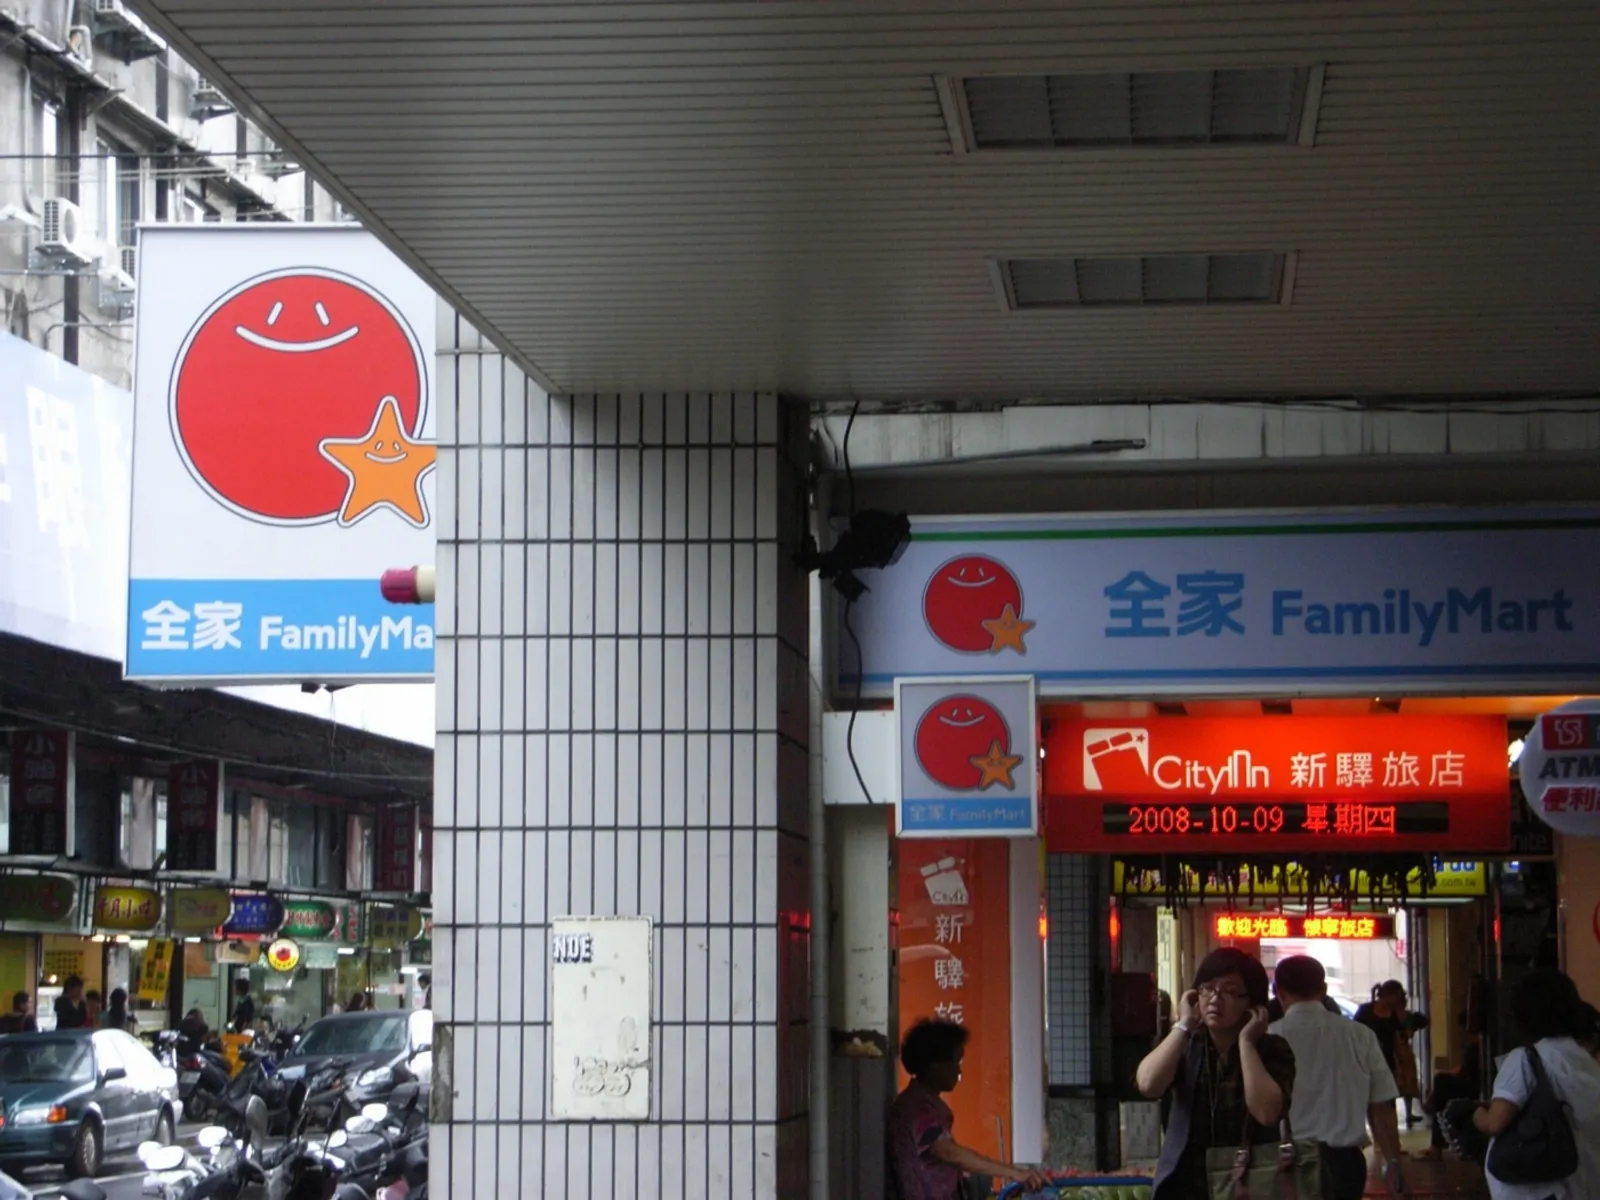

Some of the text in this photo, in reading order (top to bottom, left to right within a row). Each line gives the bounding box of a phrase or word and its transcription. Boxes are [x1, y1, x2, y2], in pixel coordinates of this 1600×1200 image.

[1104, 570, 1574, 647] 全家 FamilyMart
[141, 600, 434, 658] 全家 FamilyMa
[1290, 750, 1465, 788] 新驛旅店
[1538, 756, 1600, 779] ATM
[909, 803, 1025, 822] 全家 FamilyMart
[1541, 786, 1600, 812] 便利
[1128, 804, 1396, 834] 2008-10-09 星期四
[1216, 917, 1288, 937] 歡迎光臨
